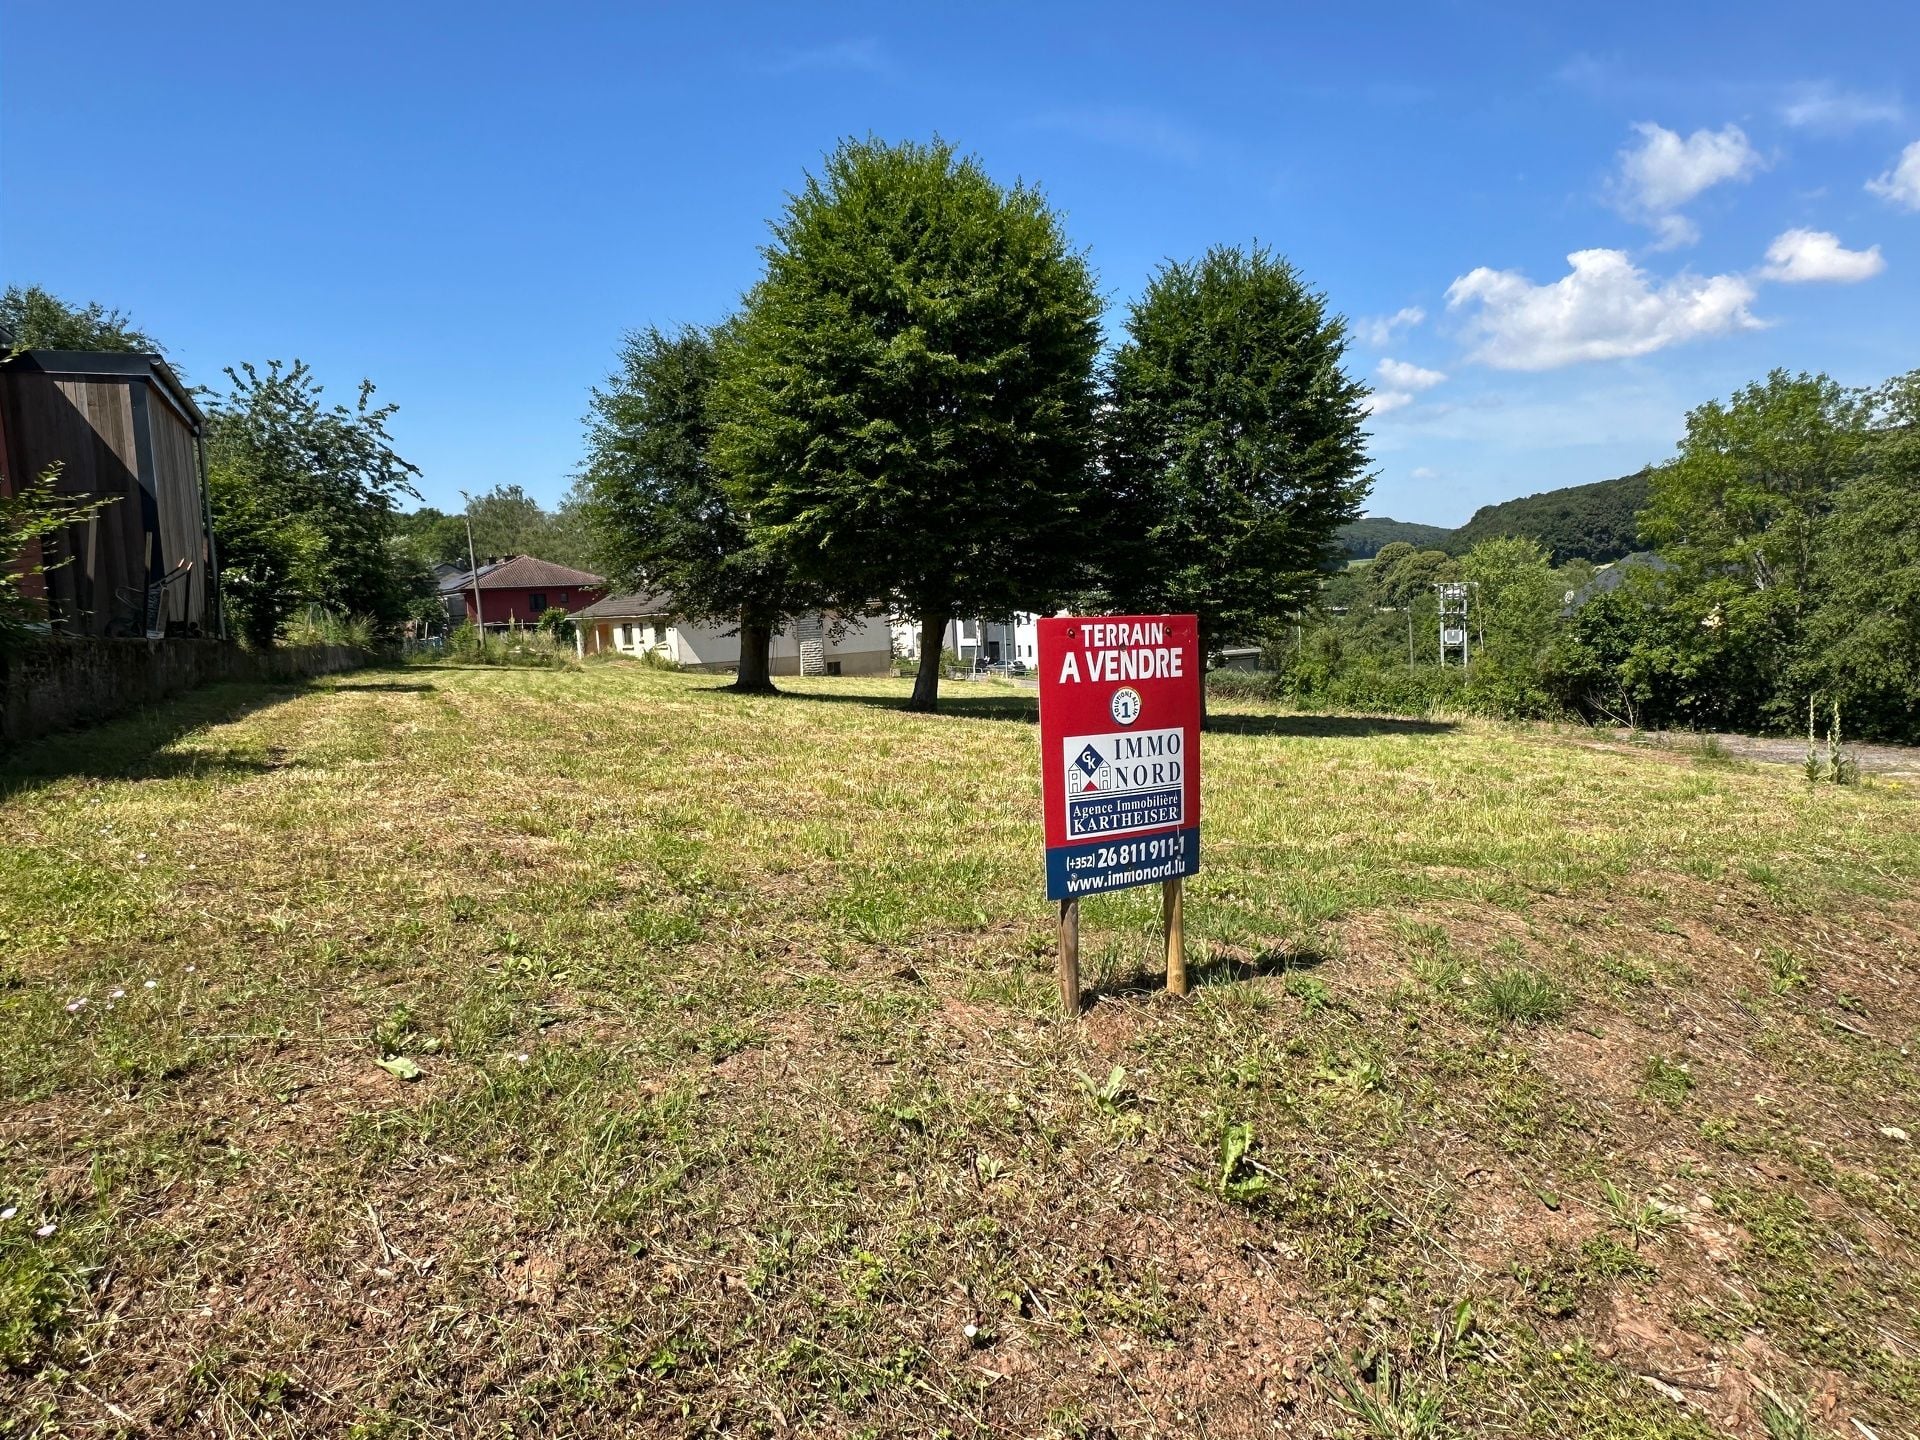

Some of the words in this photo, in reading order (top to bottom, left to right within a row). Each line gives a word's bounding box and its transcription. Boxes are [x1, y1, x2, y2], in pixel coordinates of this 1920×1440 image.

[1081, 623, 1163, 647] TERRAIN
[1059, 652, 1081, 683] A
[1086, 648, 1182, 682] VENDRE
[1121, 701, 1131, 718] 1
[1114, 734, 1180, 760] IMMO
[1115, 761, 1180, 788] NORD
[1073, 804, 1112, 819] Agence
[1117, 795, 1178, 811] Immobilière
[1074, 806, 1178, 833] KARTHEISER
[1066, 853, 1095, 871] (+352)
[1067, 859, 1185, 893] www.immonord.lu
